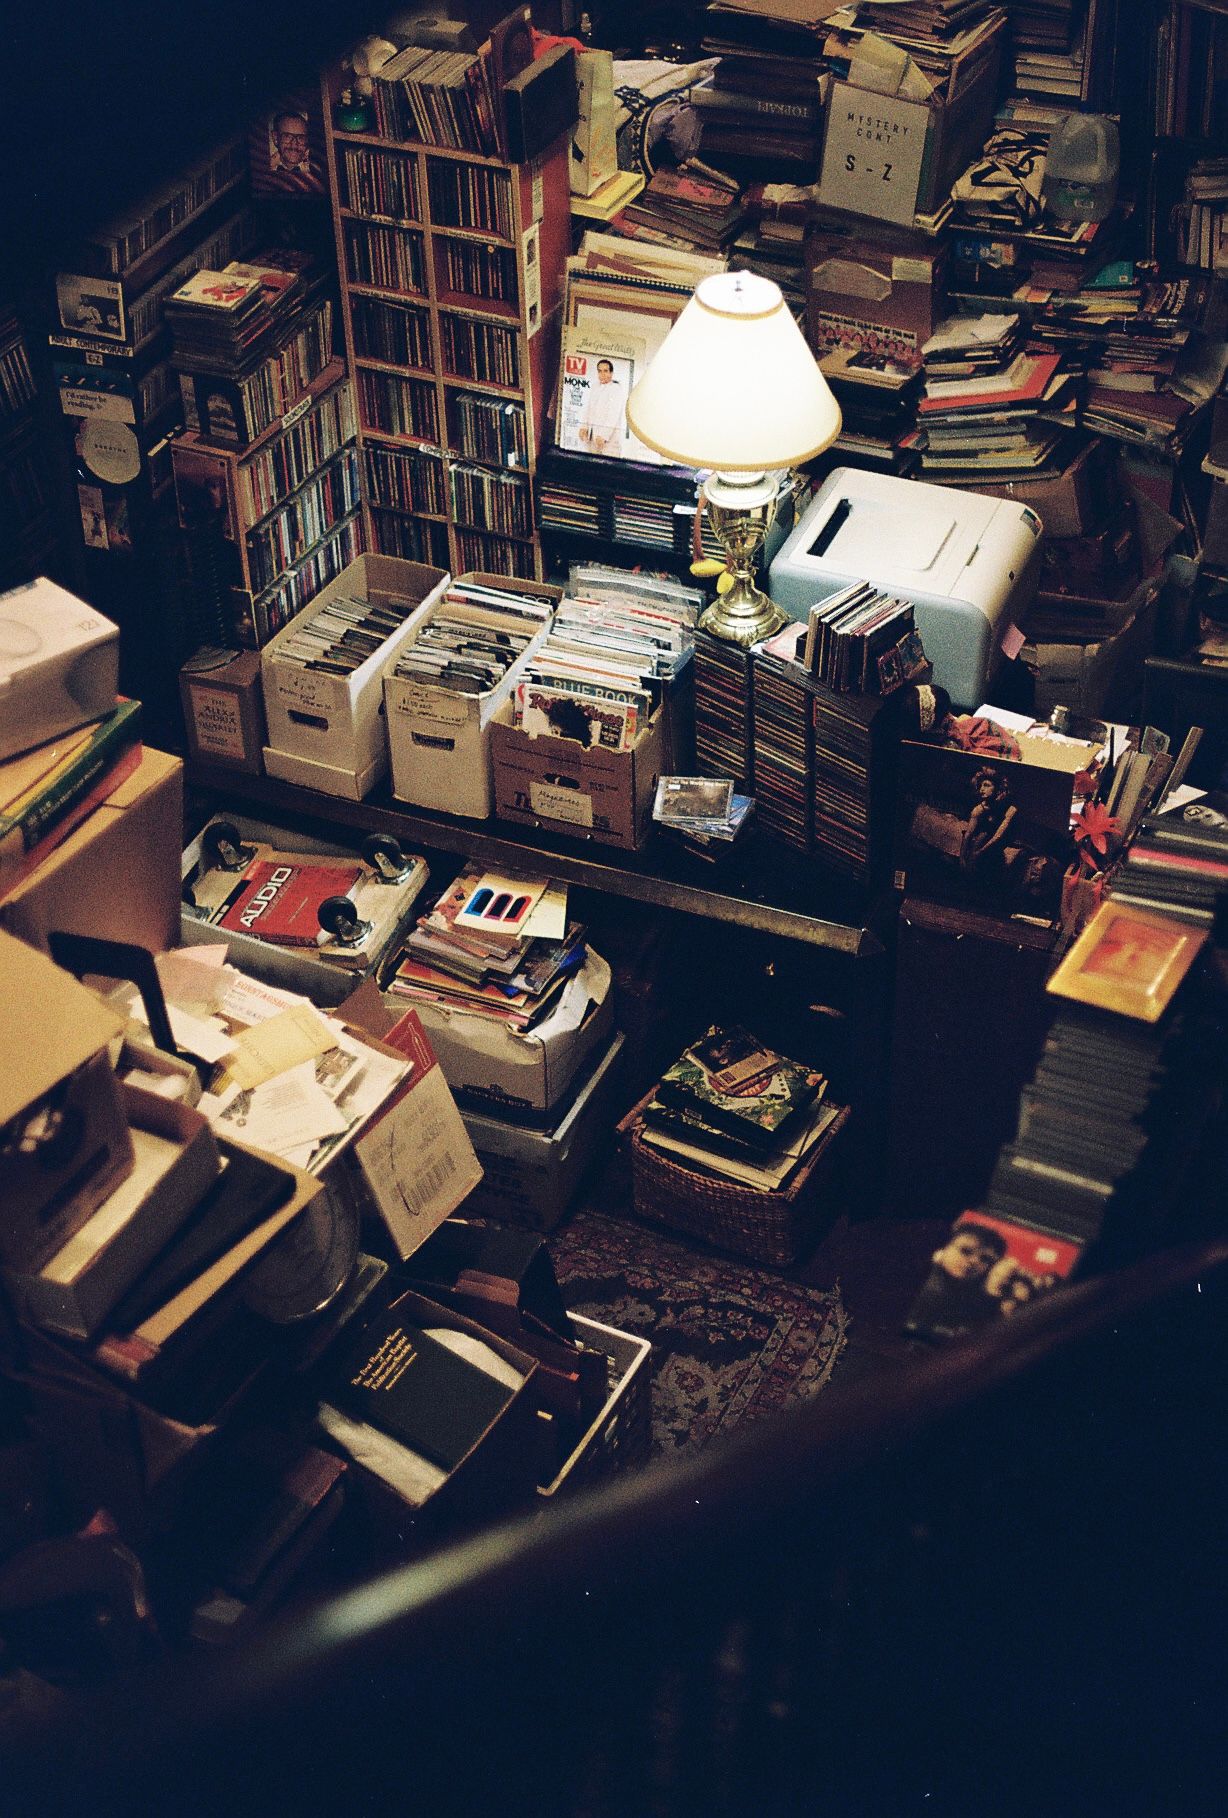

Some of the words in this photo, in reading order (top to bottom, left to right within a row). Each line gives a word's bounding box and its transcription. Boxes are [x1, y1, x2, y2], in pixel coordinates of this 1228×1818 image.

[847, 113, 909, 135] MYSTERY
[857, 128, 891, 143] CONT
[568, 357, 585, 370] TV
[564, 376, 591, 389] MONK
[553, 680, 591, 697] BLUE
[595, 688, 636, 705] BOOK
[240, 867, 293, 928] AUDIO
